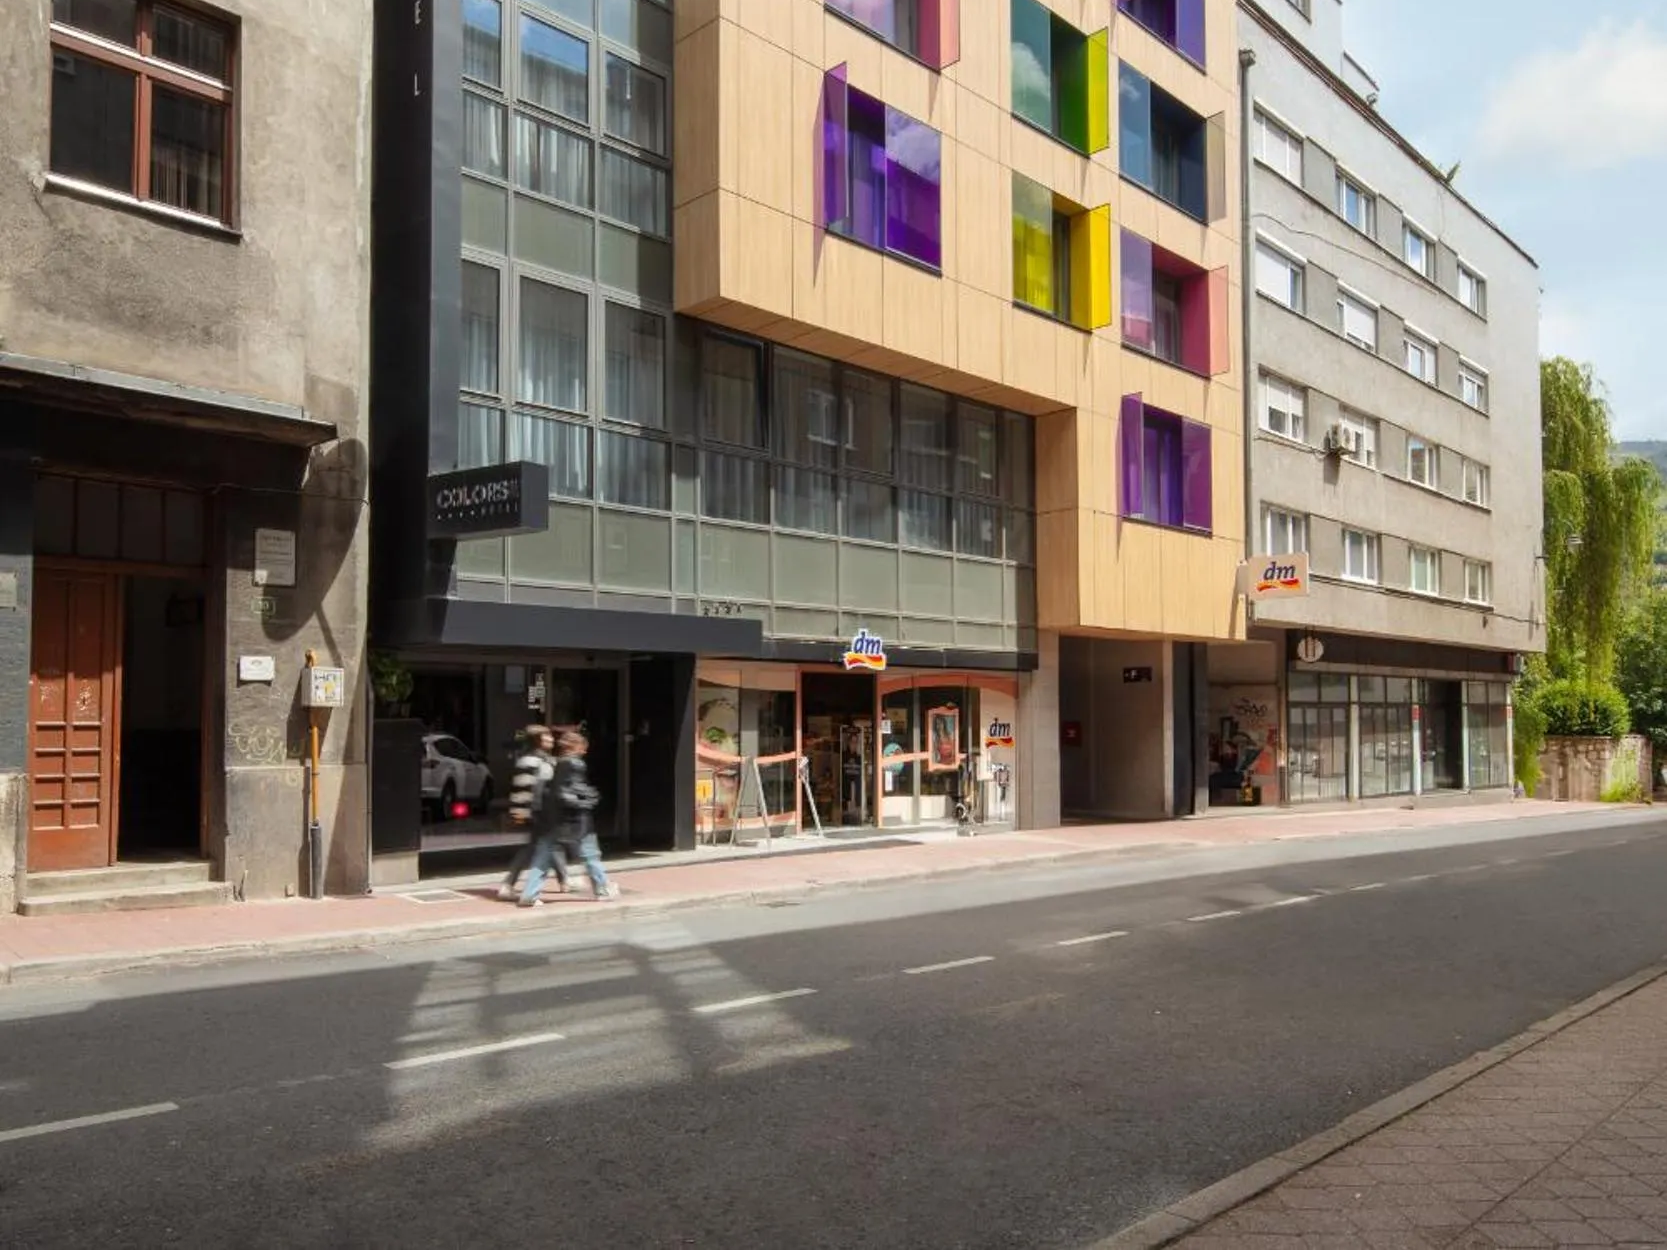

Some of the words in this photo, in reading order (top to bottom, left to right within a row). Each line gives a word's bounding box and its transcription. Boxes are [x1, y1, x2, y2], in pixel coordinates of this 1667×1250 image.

[437, 479, 509, 508] COLORS
[1263, 561, 1295, 581] dm
[853, 631, 881, 654] dm
[990, 717, 1010, 737] dm
